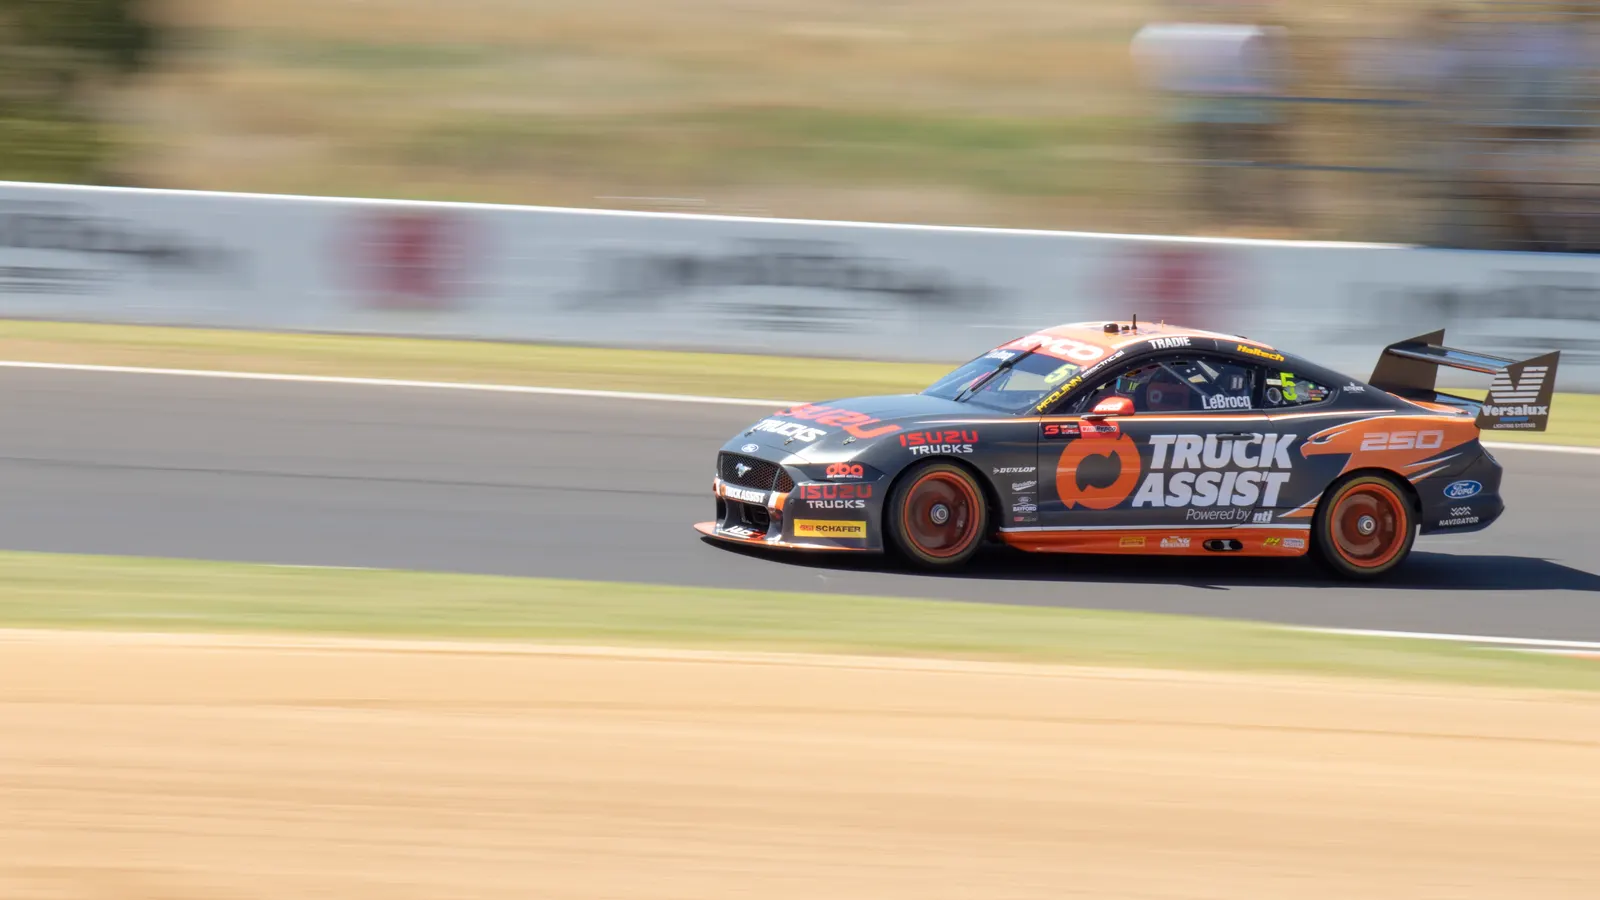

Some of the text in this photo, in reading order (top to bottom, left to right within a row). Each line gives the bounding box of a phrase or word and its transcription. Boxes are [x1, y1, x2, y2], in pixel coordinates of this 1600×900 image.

[1148, 336, 1191, 349] TRADIE
[1237, 344, 1285, 362] Haltech
[1279, 372, 1298, 401] 5
[1202, 393, 1252, 410] LeBrocq
[1481, 404, 1549, 417] Versalux
[899, 430, 979, 447] ISUZU
[909, 443, 974, 456] TRUCKS
[1148, 433, 1298, 470] TRUCK
[826, 461, 864, 477] dba
[800, 484, 873, 500] ISUZU
[1131, 470, 1292, 508] ASSIST
[807, 499, 866, 509] TRUCKS
[1185, 508, 1231, 521] Powered
[1235, 508, 1251, 522] by
[1438, 516, 1480, 527] NAVIGATOR
